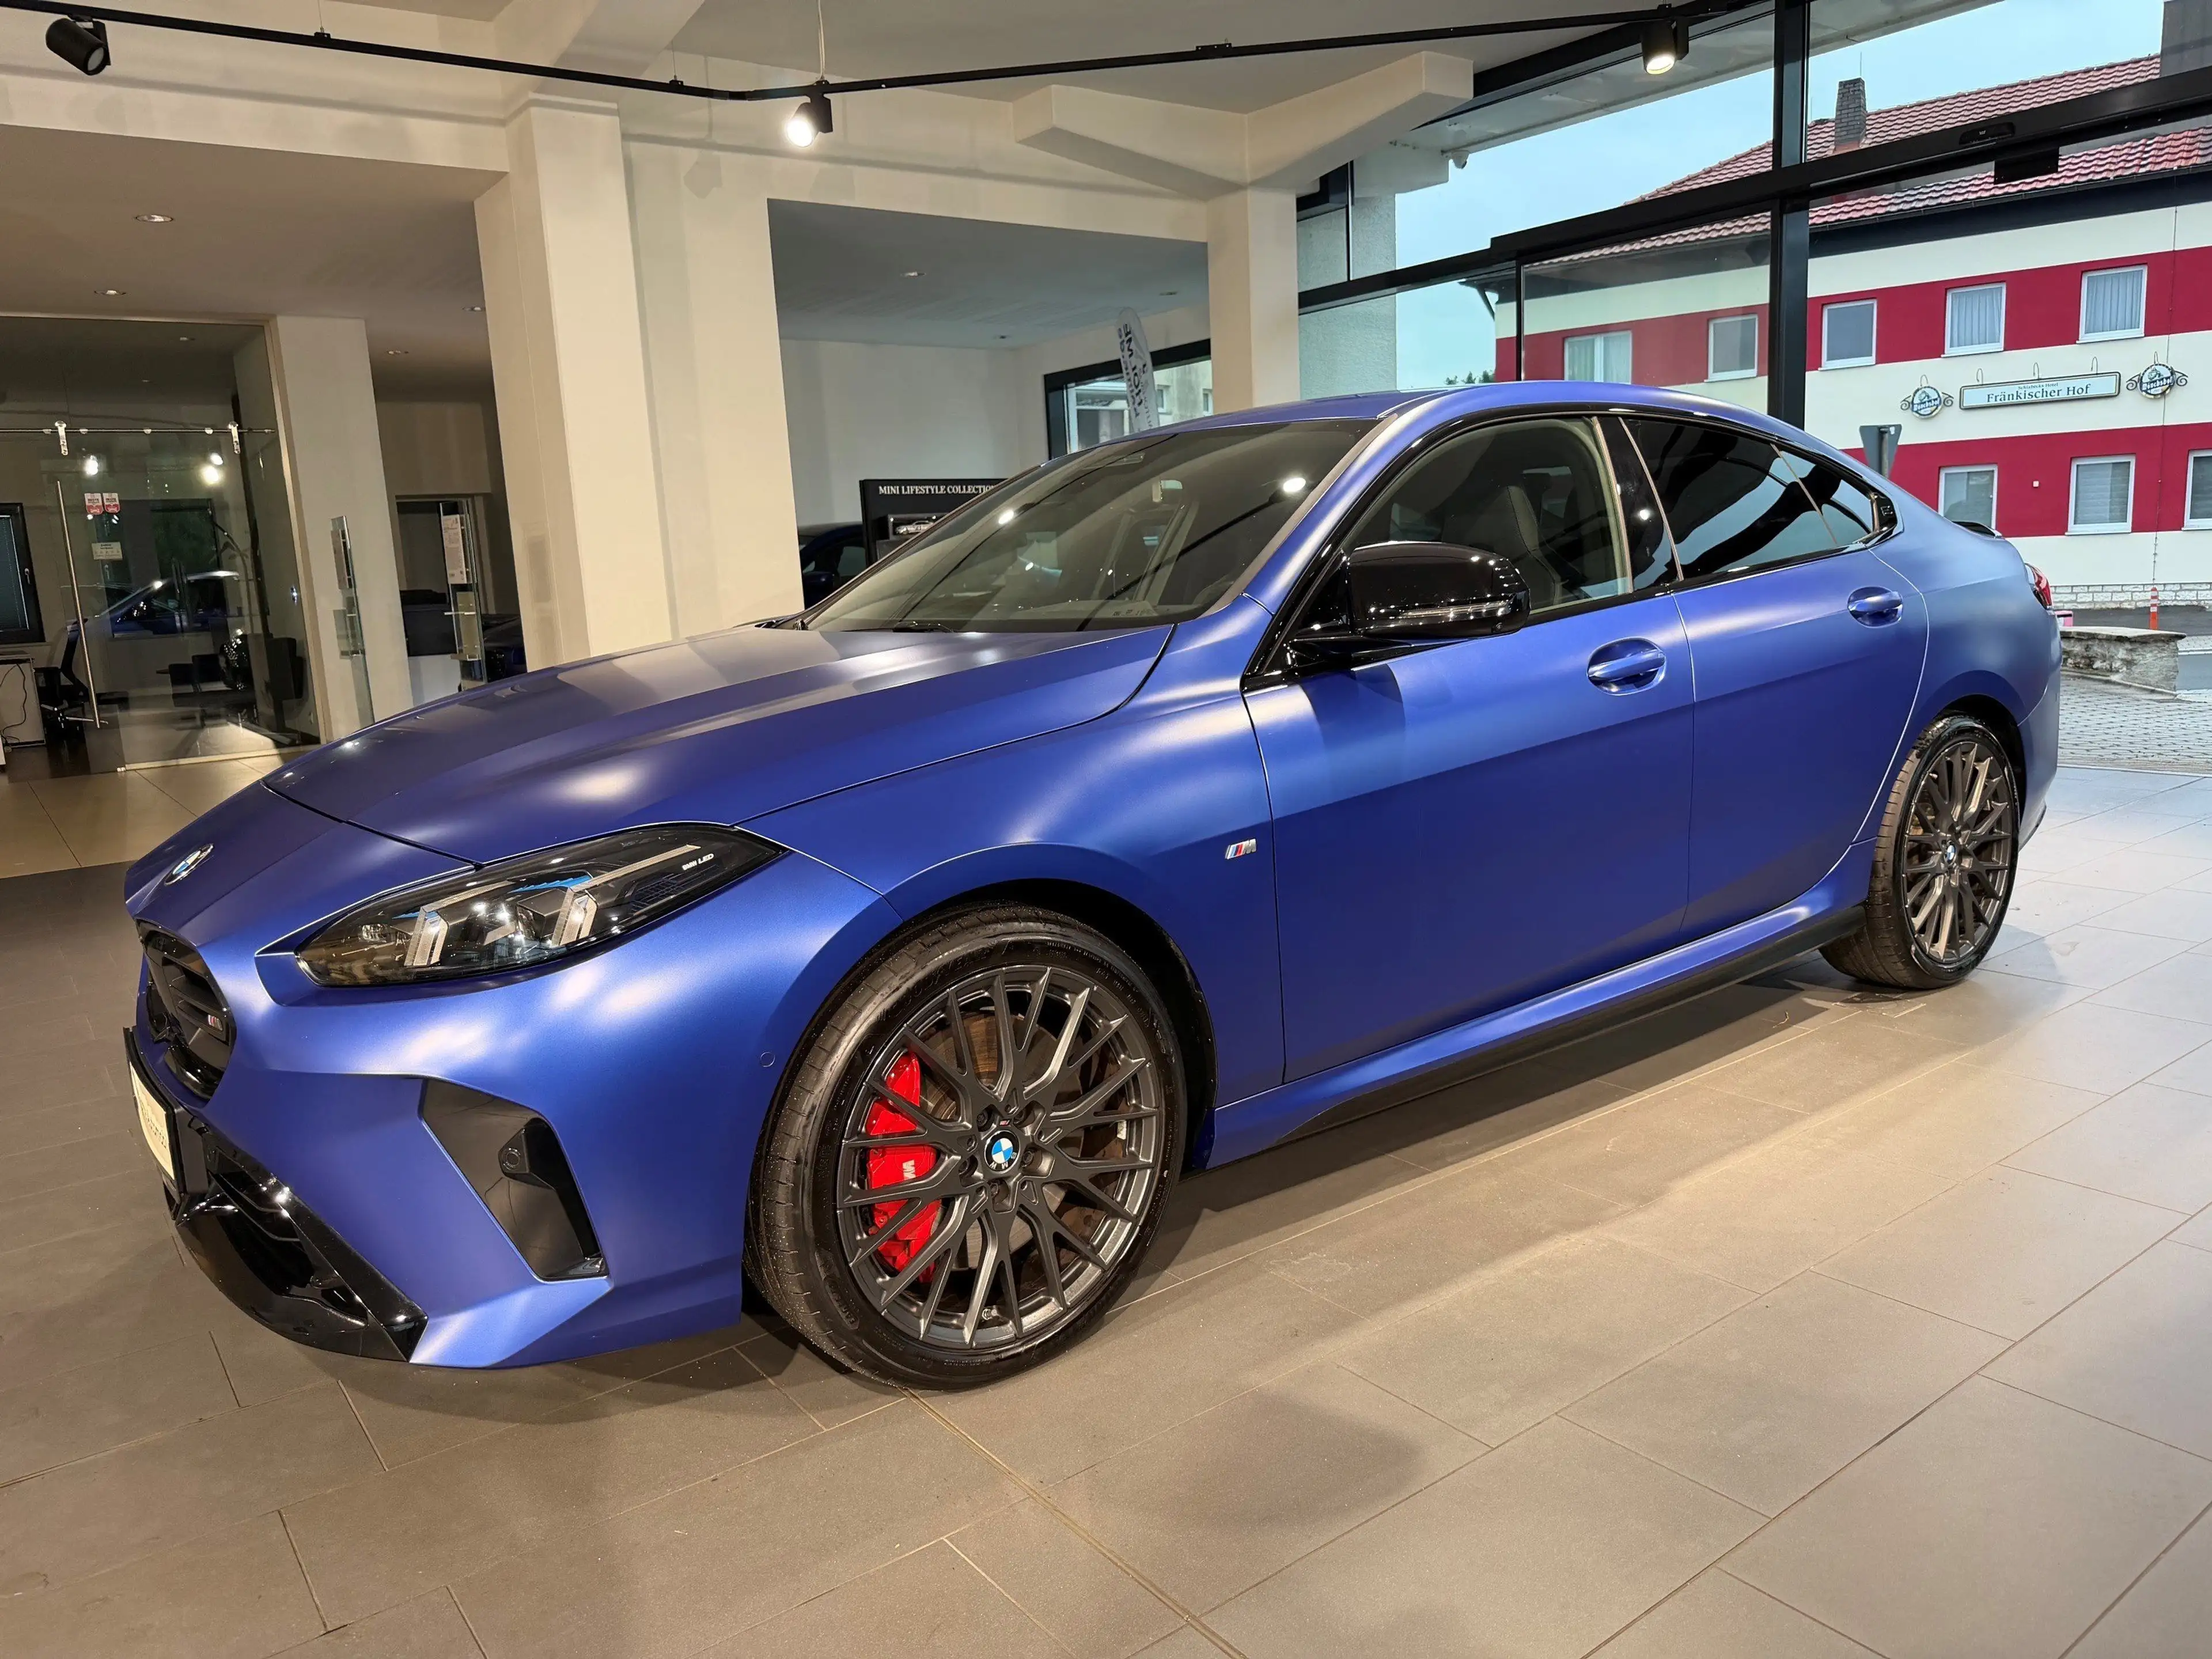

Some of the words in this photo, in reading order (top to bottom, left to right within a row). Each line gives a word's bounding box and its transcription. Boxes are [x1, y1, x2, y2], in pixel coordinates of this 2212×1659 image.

[1987, 387, 2062, 403] Fränkischer
[2066, 384, 2091, 396] Hof
[878, 486, 899, 494] MINI
[902, 485, 946, 494] LIFESTYLE
[682, 860, 697, 870] BMW
[698, 853, 714, 864] LED
